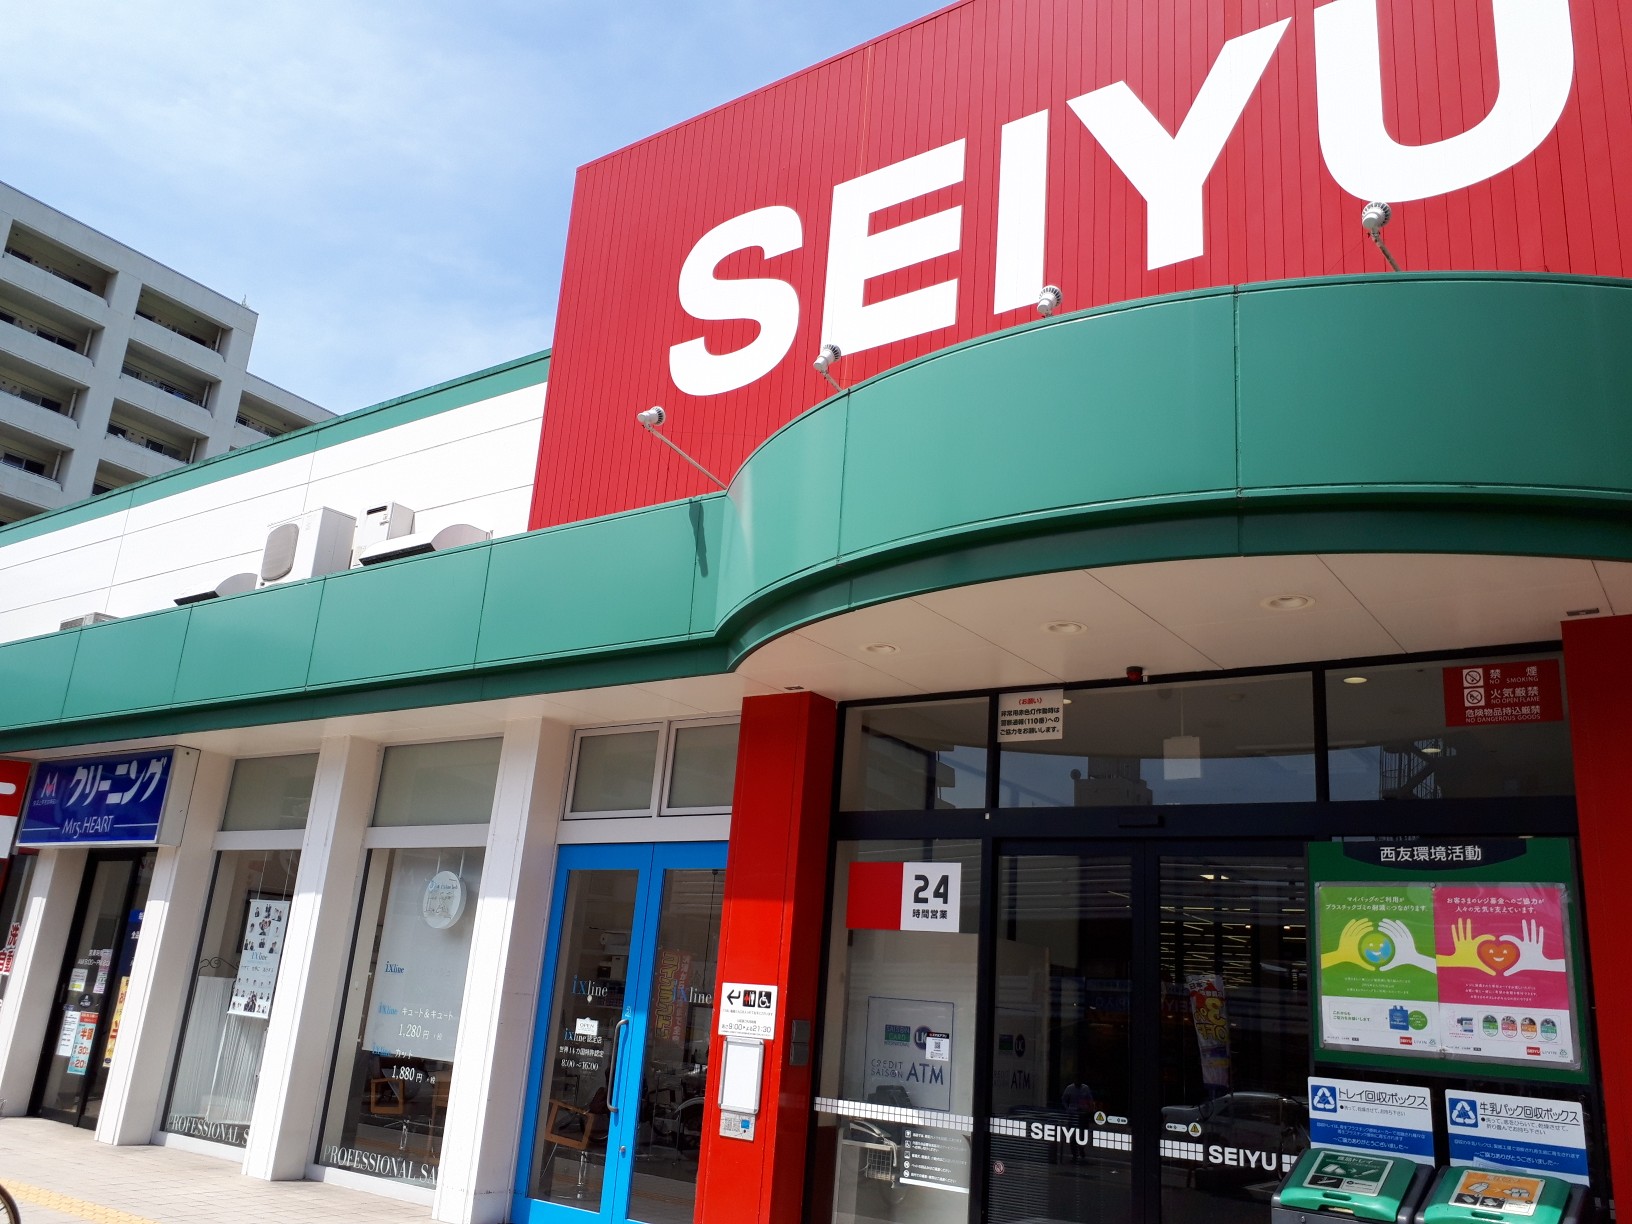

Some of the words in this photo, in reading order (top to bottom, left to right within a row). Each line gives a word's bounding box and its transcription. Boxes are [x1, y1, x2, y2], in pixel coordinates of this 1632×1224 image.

[669, 0, 1575, 397] SEIYU
[1506, 676, 1539, 684] SMOKING
[1490, 686, 1539, 698] 火気厳禁
[1519, 695, 1540, 703] FLAME
[1476, 715, 1516, 723] DANGEROUS
[1517, 713, 1541, 721] GOODS
[65, 756, 168, 808] クリーニング
[1380, 845, 1482, 862] 西友環境活動
[914, 874, 949, 905] 24
[912, 908, 948, 920] 時間営業
[871, 1058, 903, 1069] CREDIT
[906, 1062, 944, 1085] ATM
[1338, 1087, 1428, 1107] トレイ回収ボックス
[1480, 1101, 1580, 1123] 牛乳パック回収ボックス
[1031, 1122, 1088, 1146] SEIYU
[323, 1144, 416, 1180] PROFESSIONAL
[419, 1163, 440, 1185] SA
[1208, 1145, 1277, 1171] SEIYU
